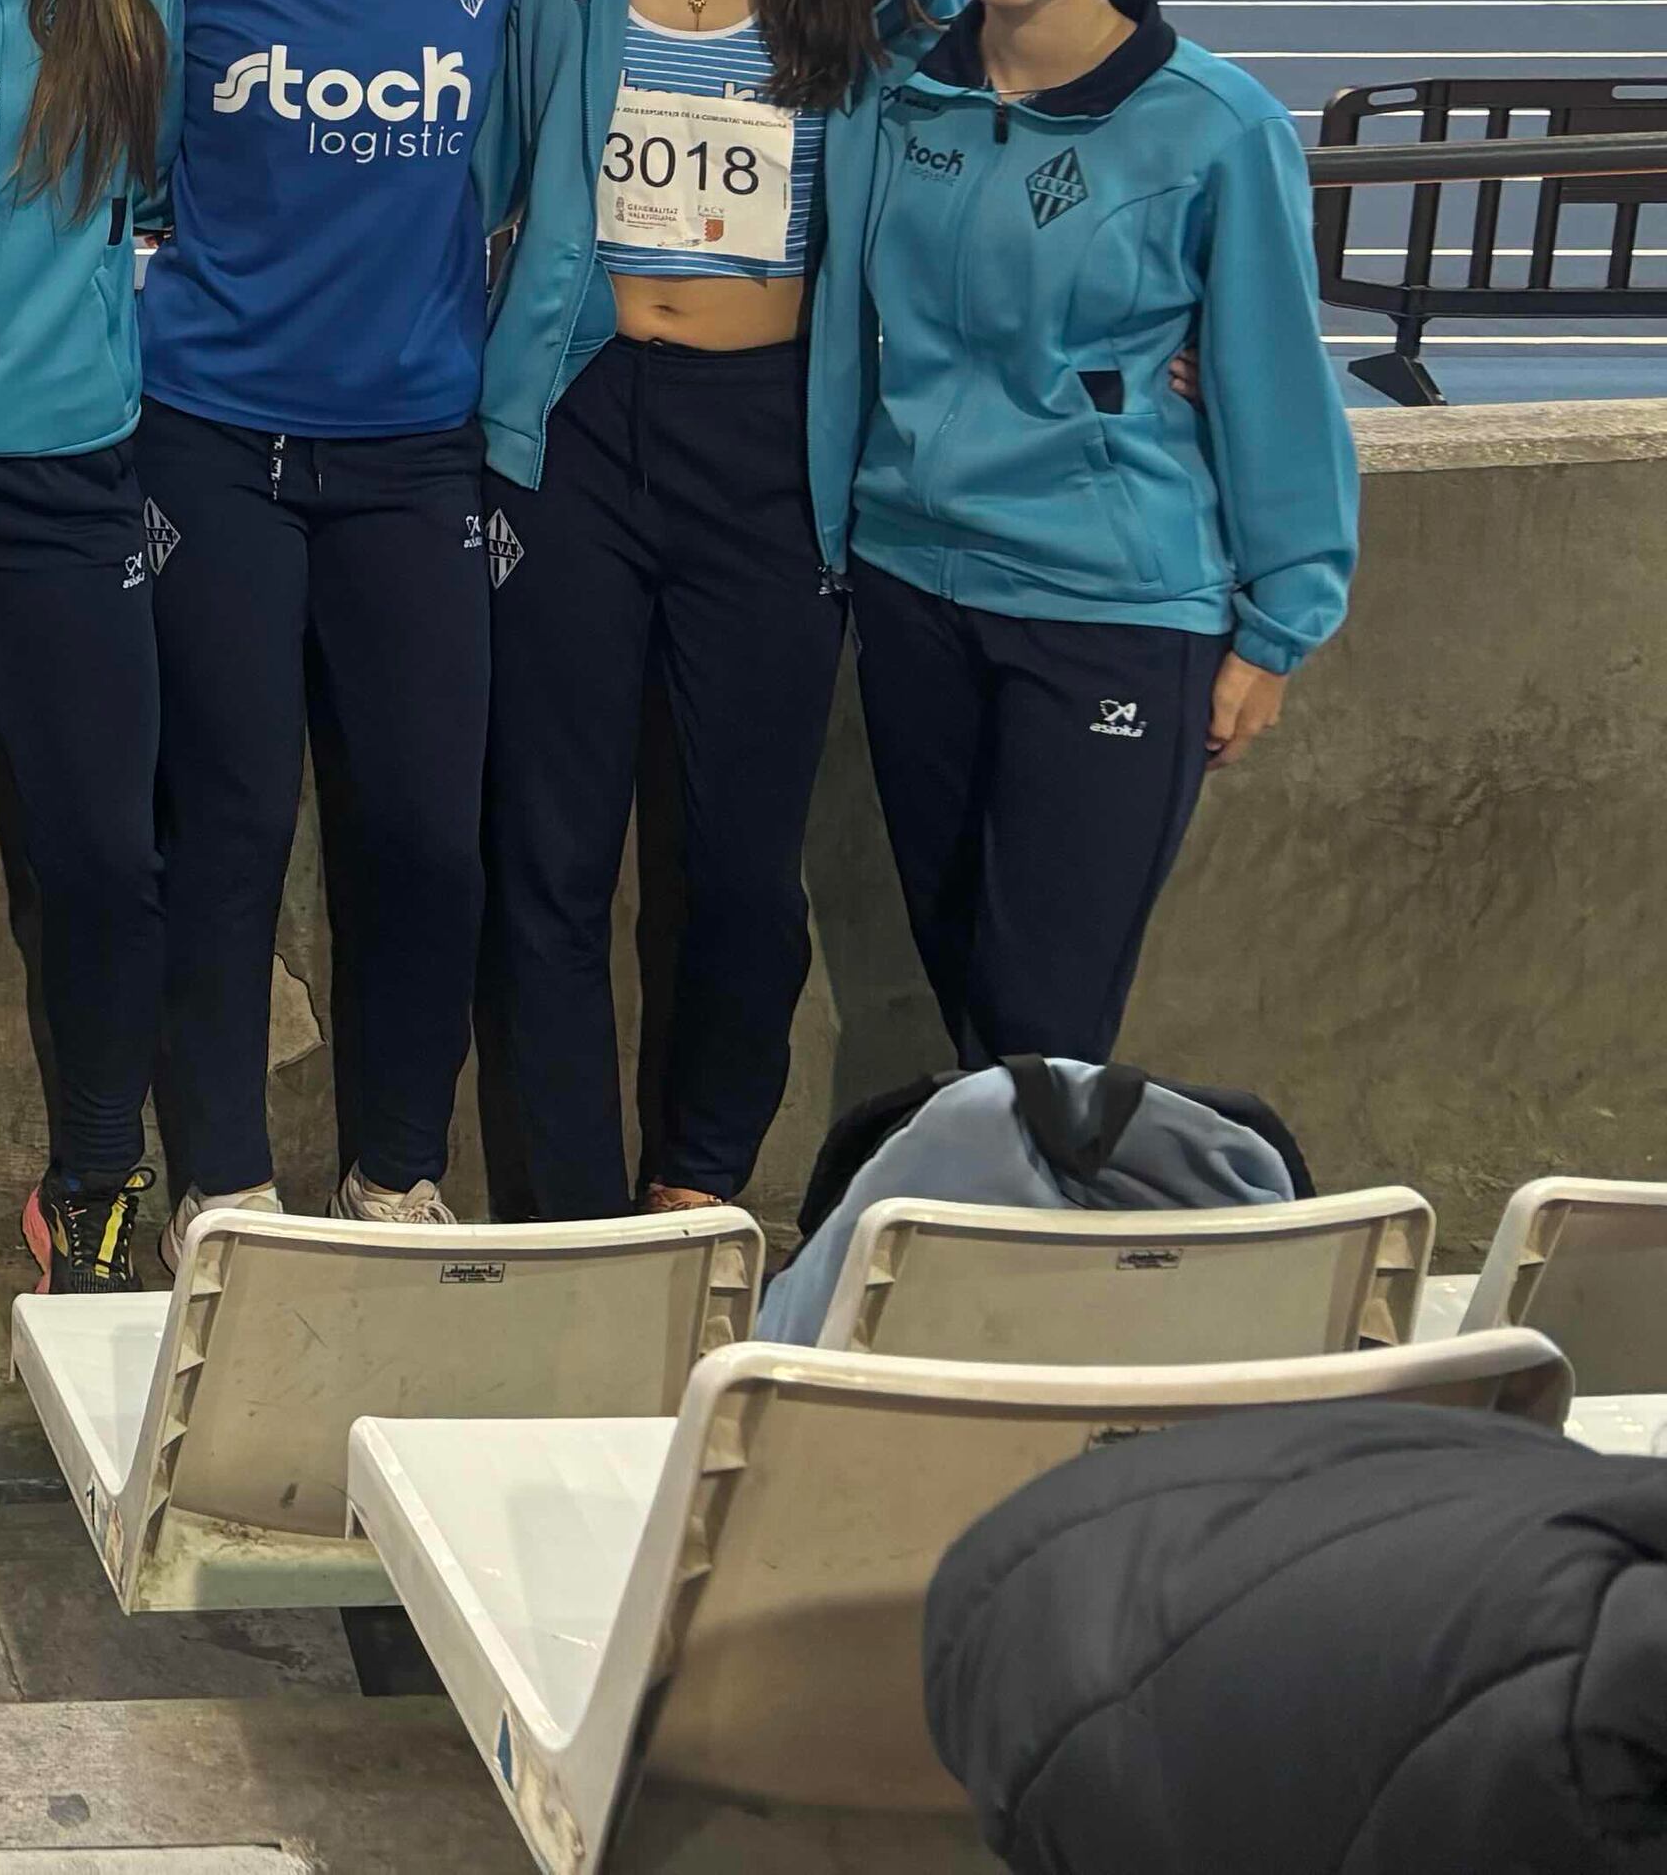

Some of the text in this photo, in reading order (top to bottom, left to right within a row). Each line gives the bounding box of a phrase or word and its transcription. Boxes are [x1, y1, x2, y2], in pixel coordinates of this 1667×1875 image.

[213, 44, 472, 122] stock
[309, 121, 464, 164] logistic
[603, 131, 760, 196] 3018
